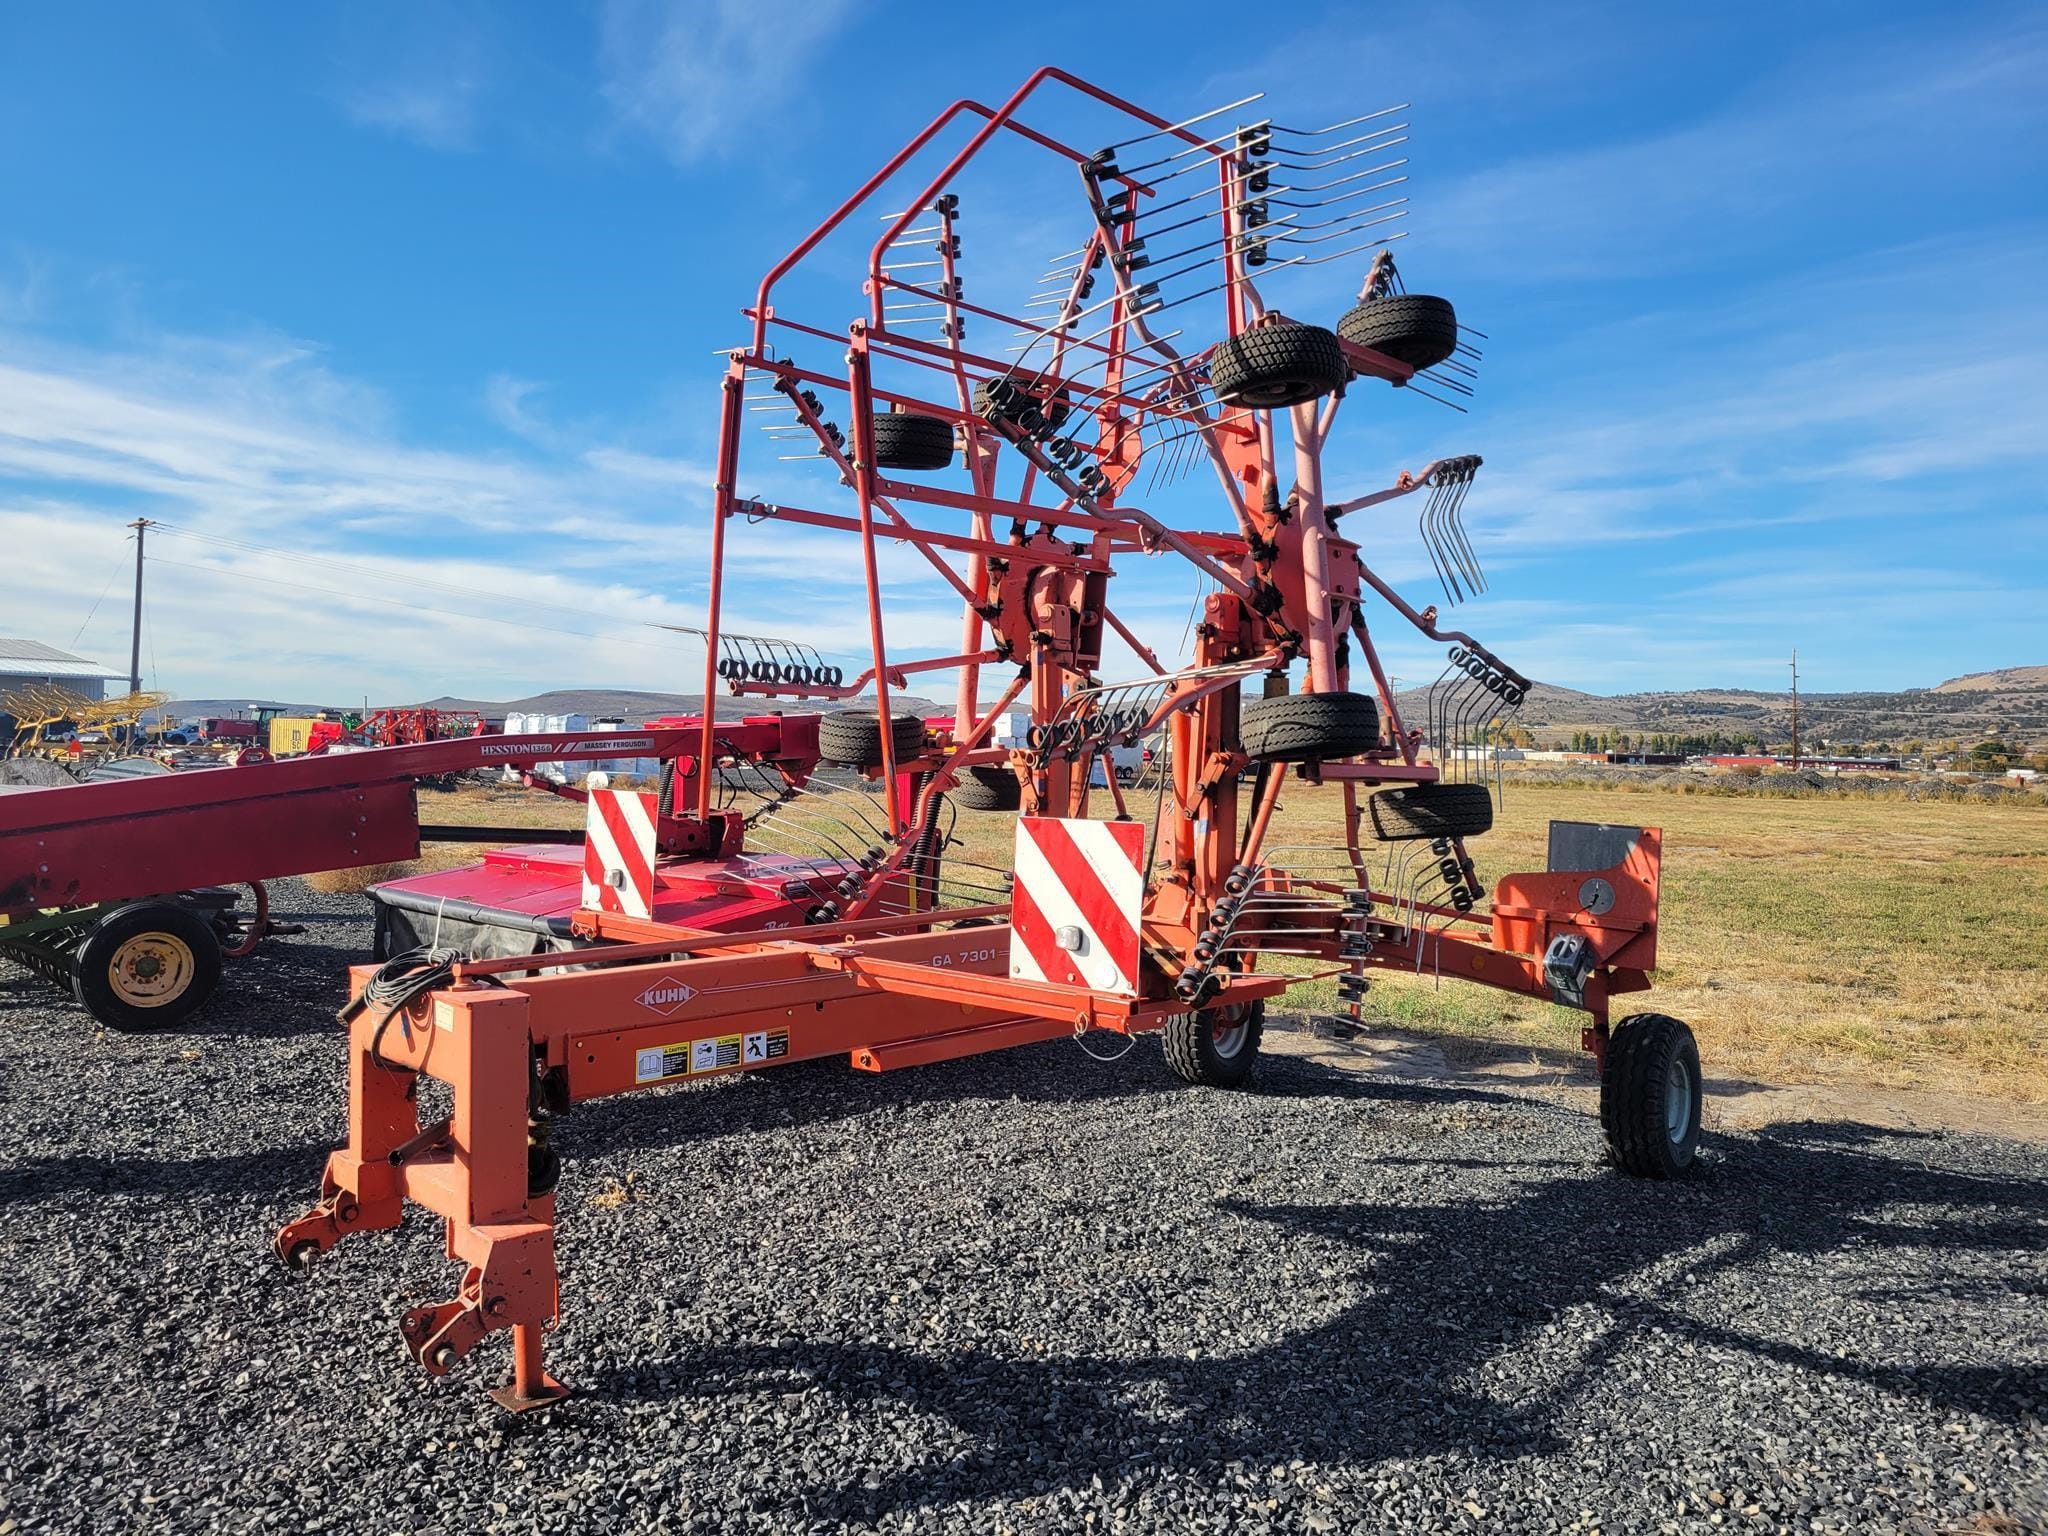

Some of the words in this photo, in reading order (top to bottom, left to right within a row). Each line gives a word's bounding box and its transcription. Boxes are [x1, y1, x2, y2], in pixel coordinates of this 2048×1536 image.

[481, 744, 531, 755] HESSTON
[585, 741, 611, 749] MASSEY
[613, 740, 647, 748] FERGUSON
[932, 953, 952, 967] GA
[960, 948, 996, 963] 7301
[644, 986, 690, 1005] KUHN
